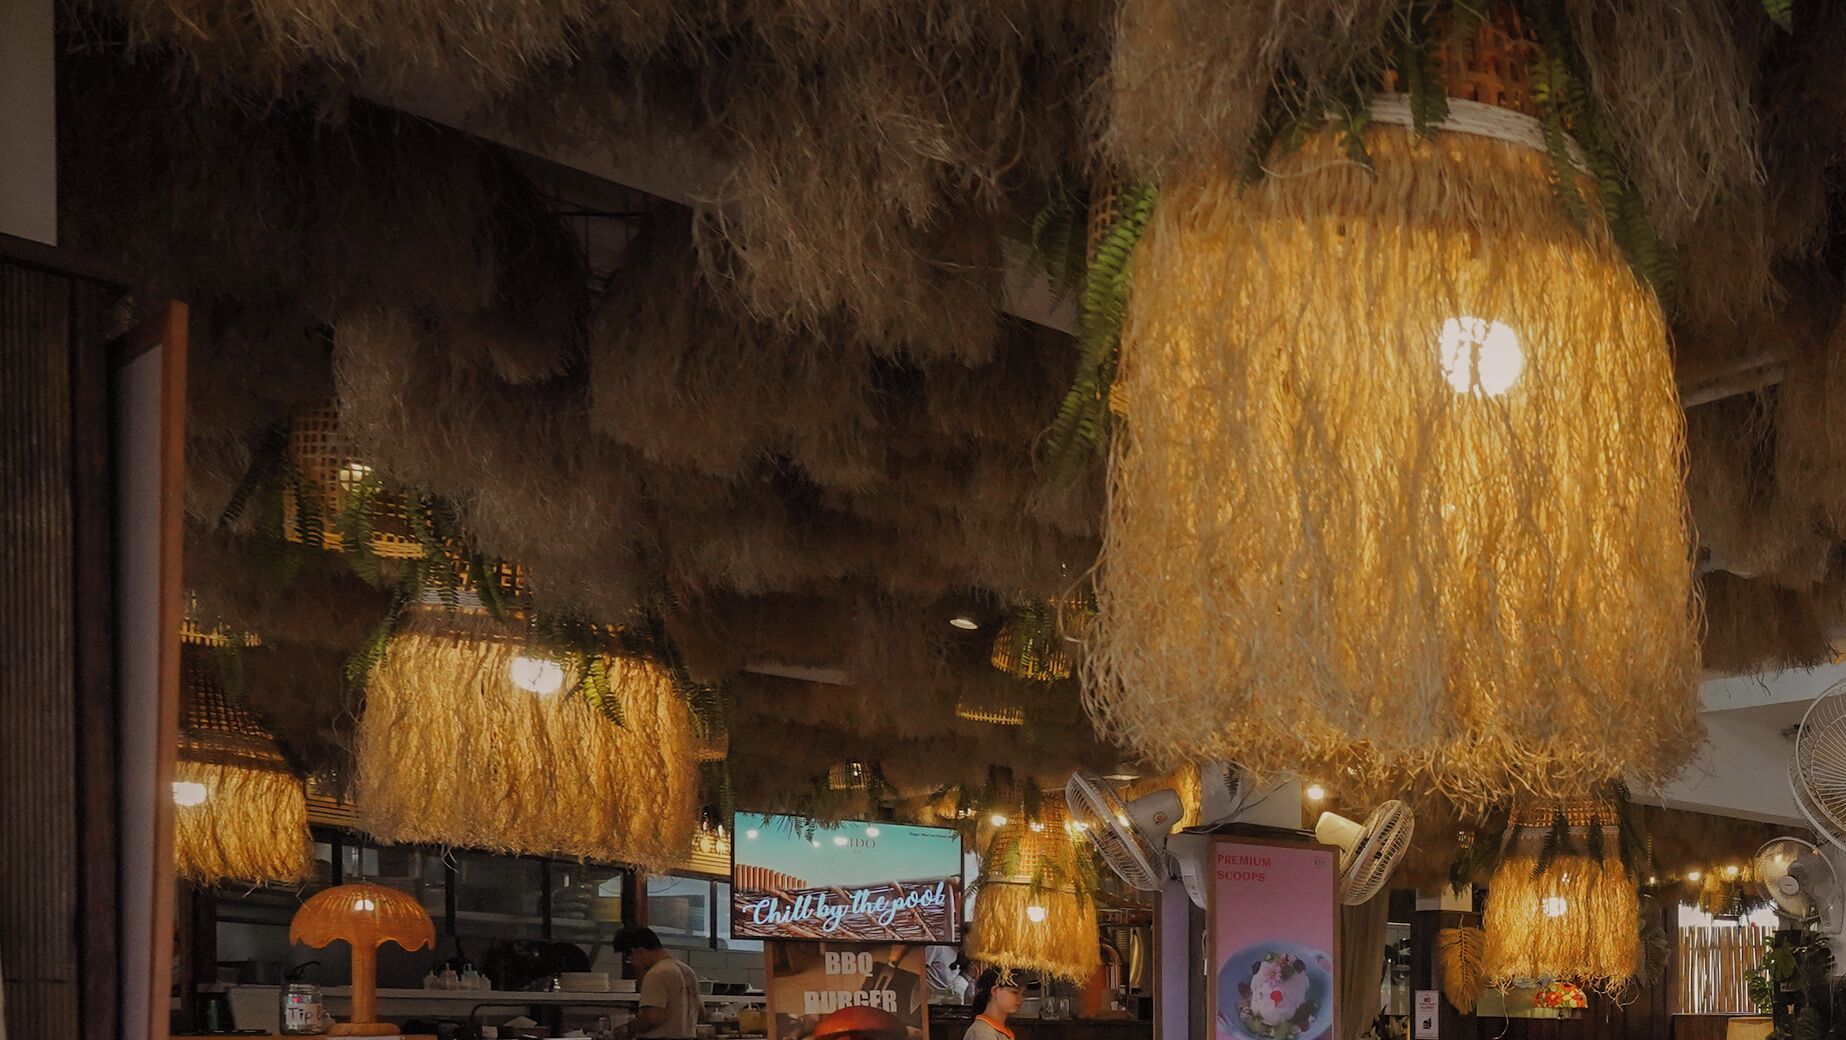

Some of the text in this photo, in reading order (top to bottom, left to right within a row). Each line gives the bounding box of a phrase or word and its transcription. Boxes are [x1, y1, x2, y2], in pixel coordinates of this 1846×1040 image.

[1217, 854, 1272, 867] PREMIUM
[1216, 870, 1265, 882] SCOOPS
[743, 881, 946, 932] Chill by the pool
[825, 951, 874, 977] BBQ
[803, 989, 898, 1014] BURGER
